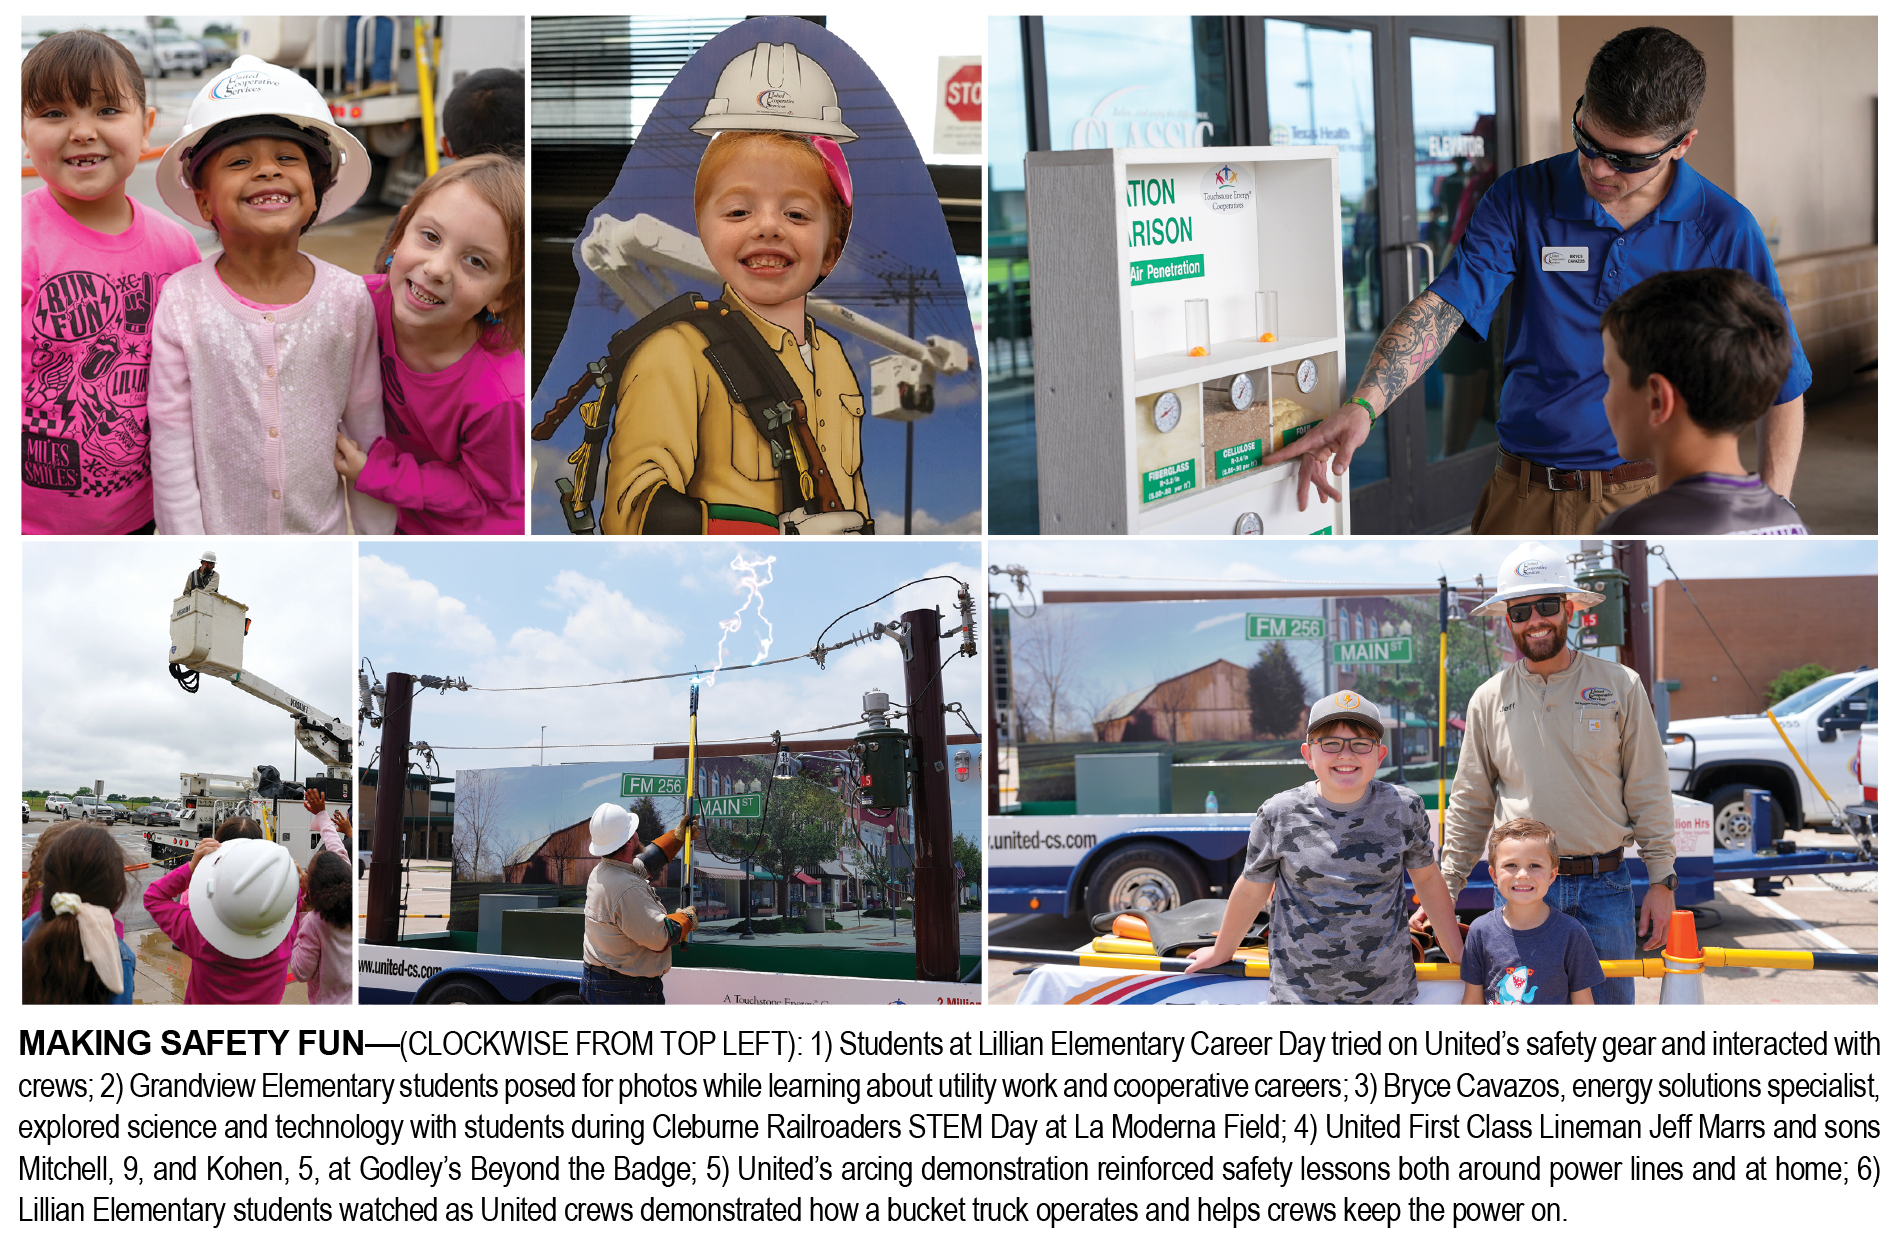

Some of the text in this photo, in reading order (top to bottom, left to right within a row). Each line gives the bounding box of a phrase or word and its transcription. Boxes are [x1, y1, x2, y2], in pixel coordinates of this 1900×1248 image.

[226, 79, 280, 90] Cooperative
[228, 72, 260, 84] United
[224, 86, 262, 98] Services
[1072, 118, 1214, 150] CLASSIC
[1291, 126, 1350, 139] Texas Health
[1429, 135, 1485, 158] ELEVATOR
[1204, 191, 1233, 201] Touchstone
[1212, 202, 1244, 211] Cooperatives
[1128, 216, 1193, 248] RISON
[1130, 260, 1200, 282] Air Penetration
[45, 274, 98, 313] RUN
[50, 300, 104, 338] FUN
[27, 438, 70, 467] MILES
[1223, 442, 1255, 458] CELLULOSE
[25, 460, 77, 486] SMILES
[1148, 461, 1189, 482] FIBERGLASS
[1174, 485, 1182, 493] per
[1256, 618, 1320, 637] FM 256
[1581, 614, 1596, 627] 1.5
[1341, 641, 1403, 661] MAIN ST
[630, 777, 681, 793] FM 256
[700, 797, 753, 816] MAIN ST
[1694, 818, 1710, 829] Hrs
[988, 830, 1096, 849] .united-cs.com
[723, 994, 731, 1003] A
